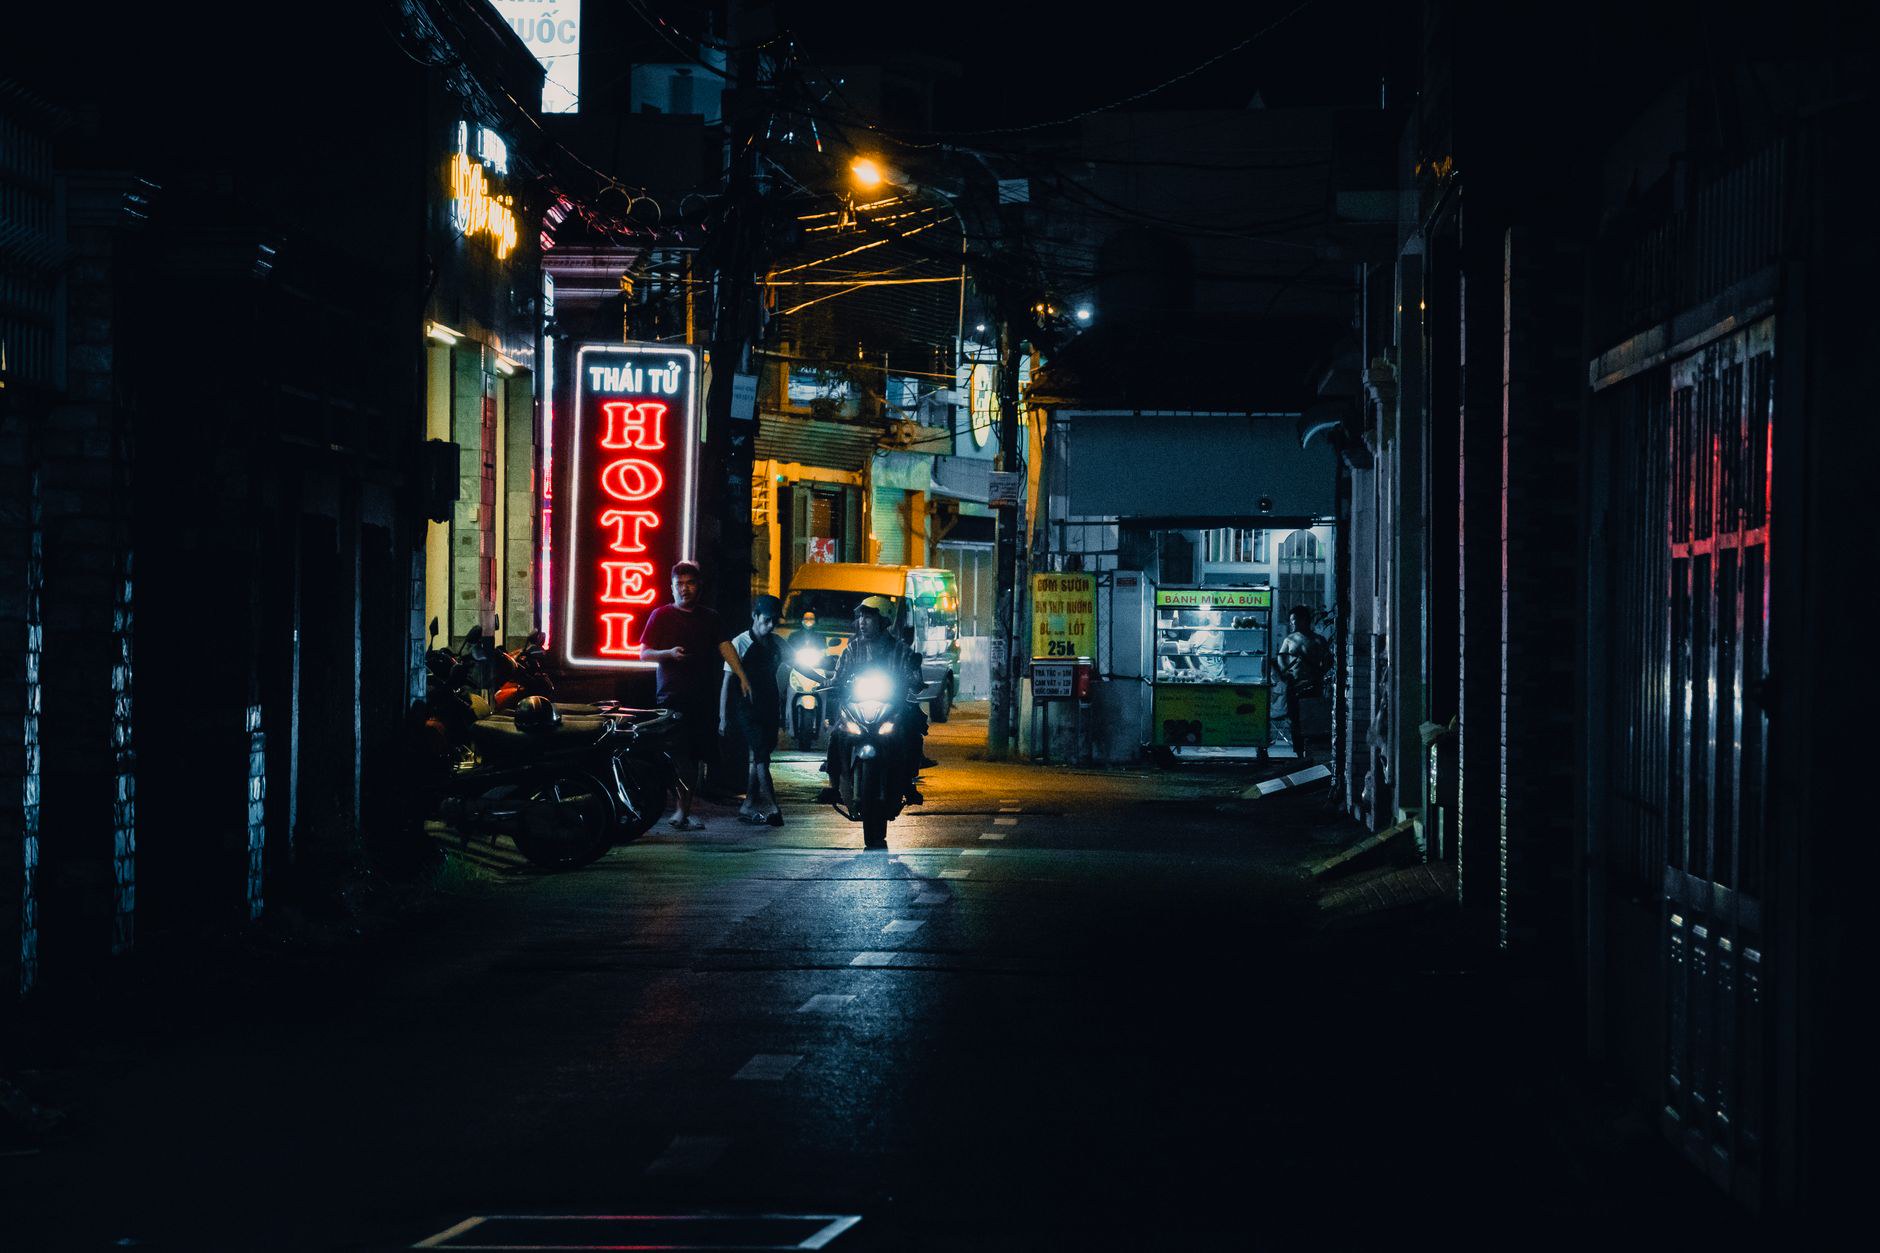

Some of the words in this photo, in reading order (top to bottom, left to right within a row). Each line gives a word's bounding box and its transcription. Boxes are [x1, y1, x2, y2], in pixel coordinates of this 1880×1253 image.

[508, 10, 576, 44] UỐC
[589, 362, 643, 392] THÁI
[648, 361, 681, 394] TỬ
[601, 402, 667, 655] HOTEL
[1165, 592, 1197, 603] BÁNH
[1239, 593, 1262, 604] BÚN
